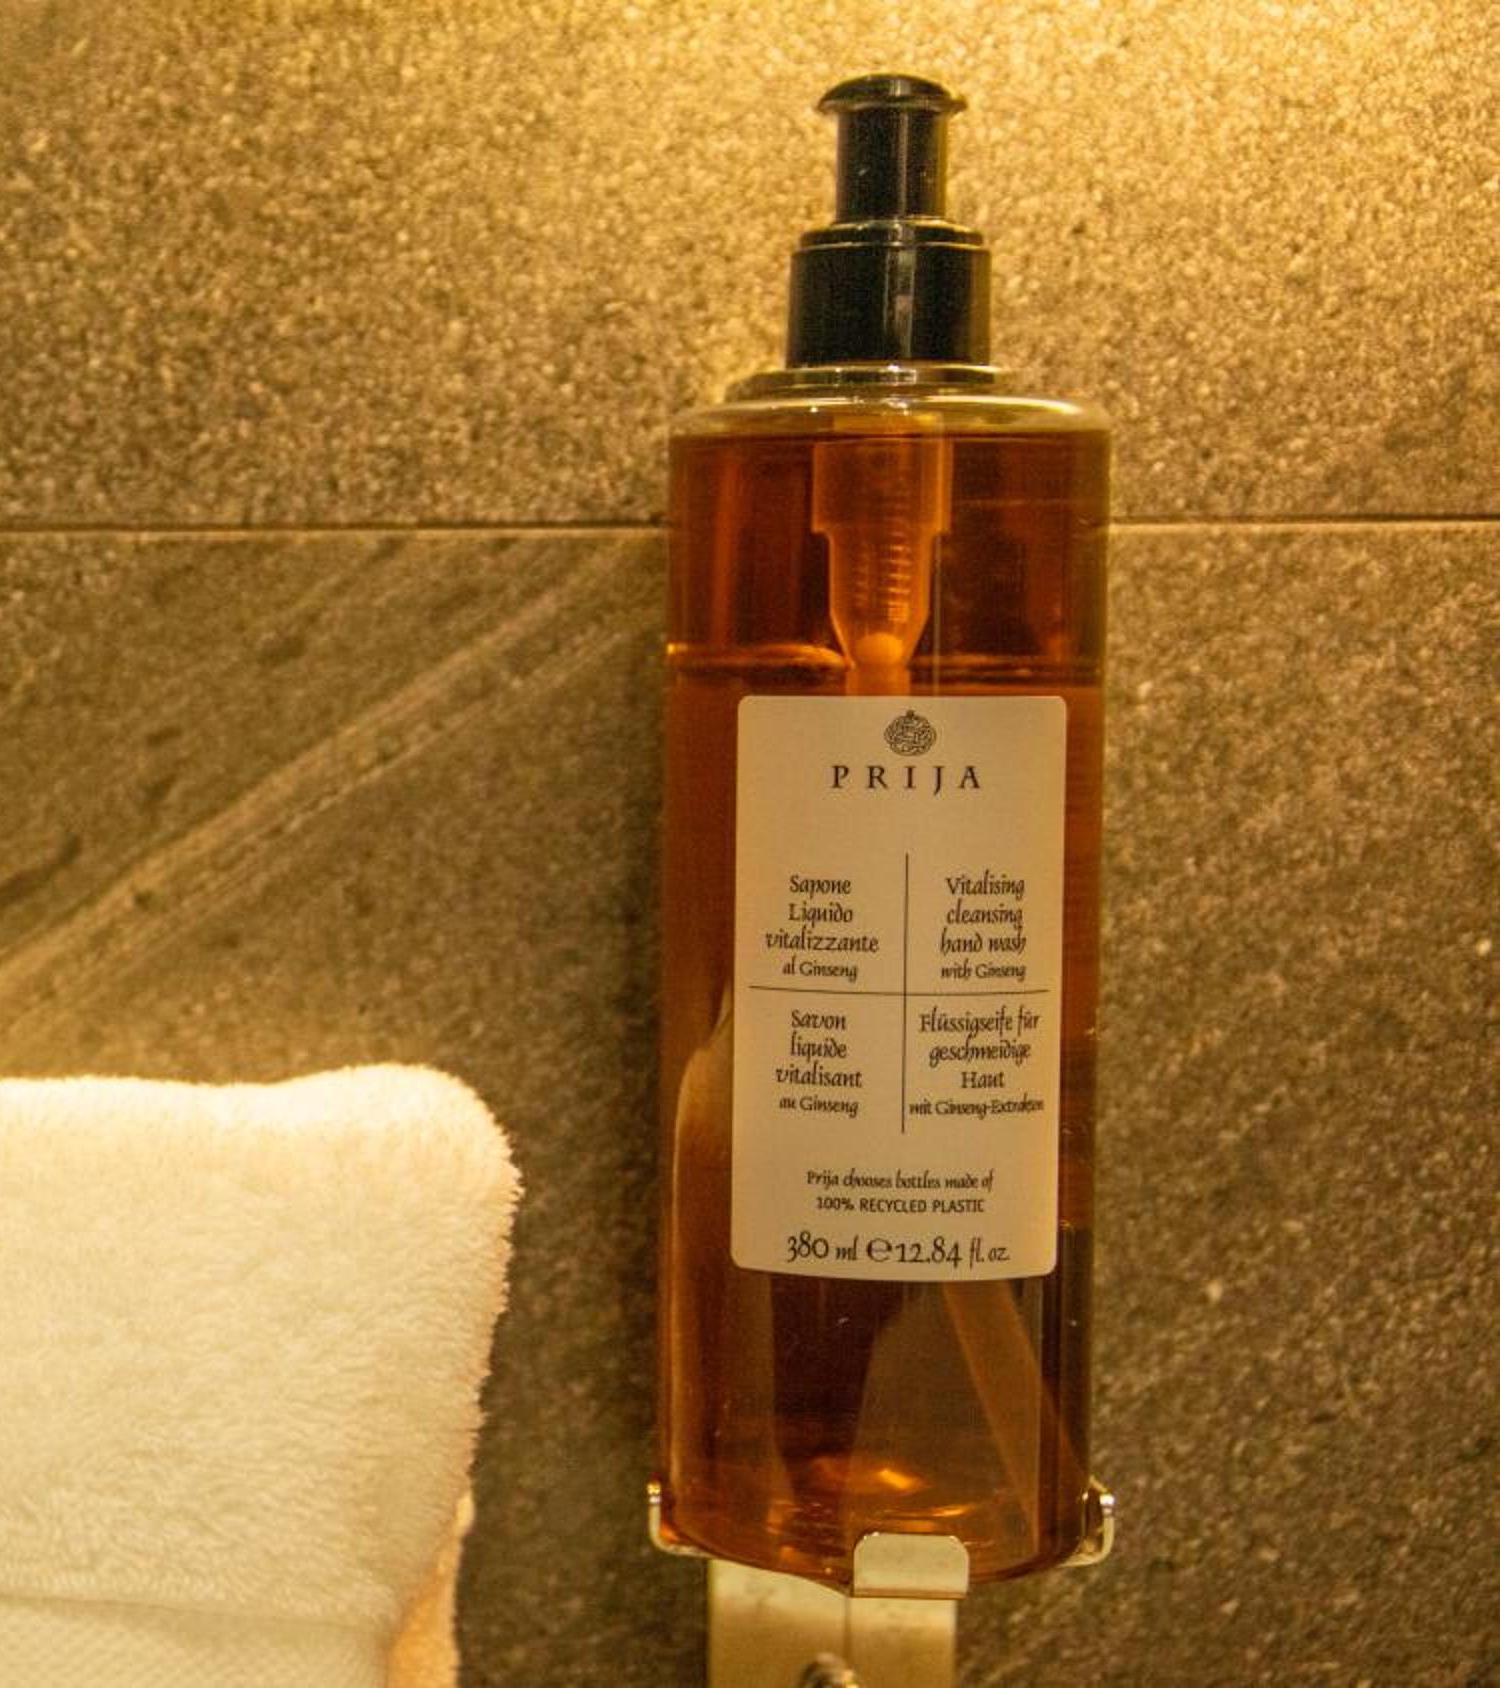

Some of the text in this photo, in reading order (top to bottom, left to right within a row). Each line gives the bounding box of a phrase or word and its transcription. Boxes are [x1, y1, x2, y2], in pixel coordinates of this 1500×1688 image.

[831, 765, 980, 796] PRIJA
[789, 874, 851, 900] Sapone
[945, 869, 1025, 901] Vitalising
[788, 902, 853, 928] Liquido
[946, 899, 1024, 930] cleansing
[765, 925, 879, 954] vitalizzante
[940, 927, 1027, 957] hand wash
[782, 955, 859, 984] al Ginseng
[940, 958, 1027, 983] with Ginseng
[791, 1010, 846, 1030] Savon
[918, 1005, 1041, 1037] Flüssigseife für
[790, 1030, 847, 1060] liquide
[928, 1034, 1032, 1068] geschmeidige
[776, 1060, 862, 1088] vitalisant
[961, 1071, 1005, 1089] Haut
[779, 1094, 859, 1119] au Ginseng
[909, 1097, 933, 1115] mit
[807, 1168, 994, 1193] Prija chooses bottles made of
[816, 1196, 985, 1214] 100% RECYCLED PLASTIC
[787, 1229, 830, 1263] 380
[835, 1234, 859, 1262] ml
